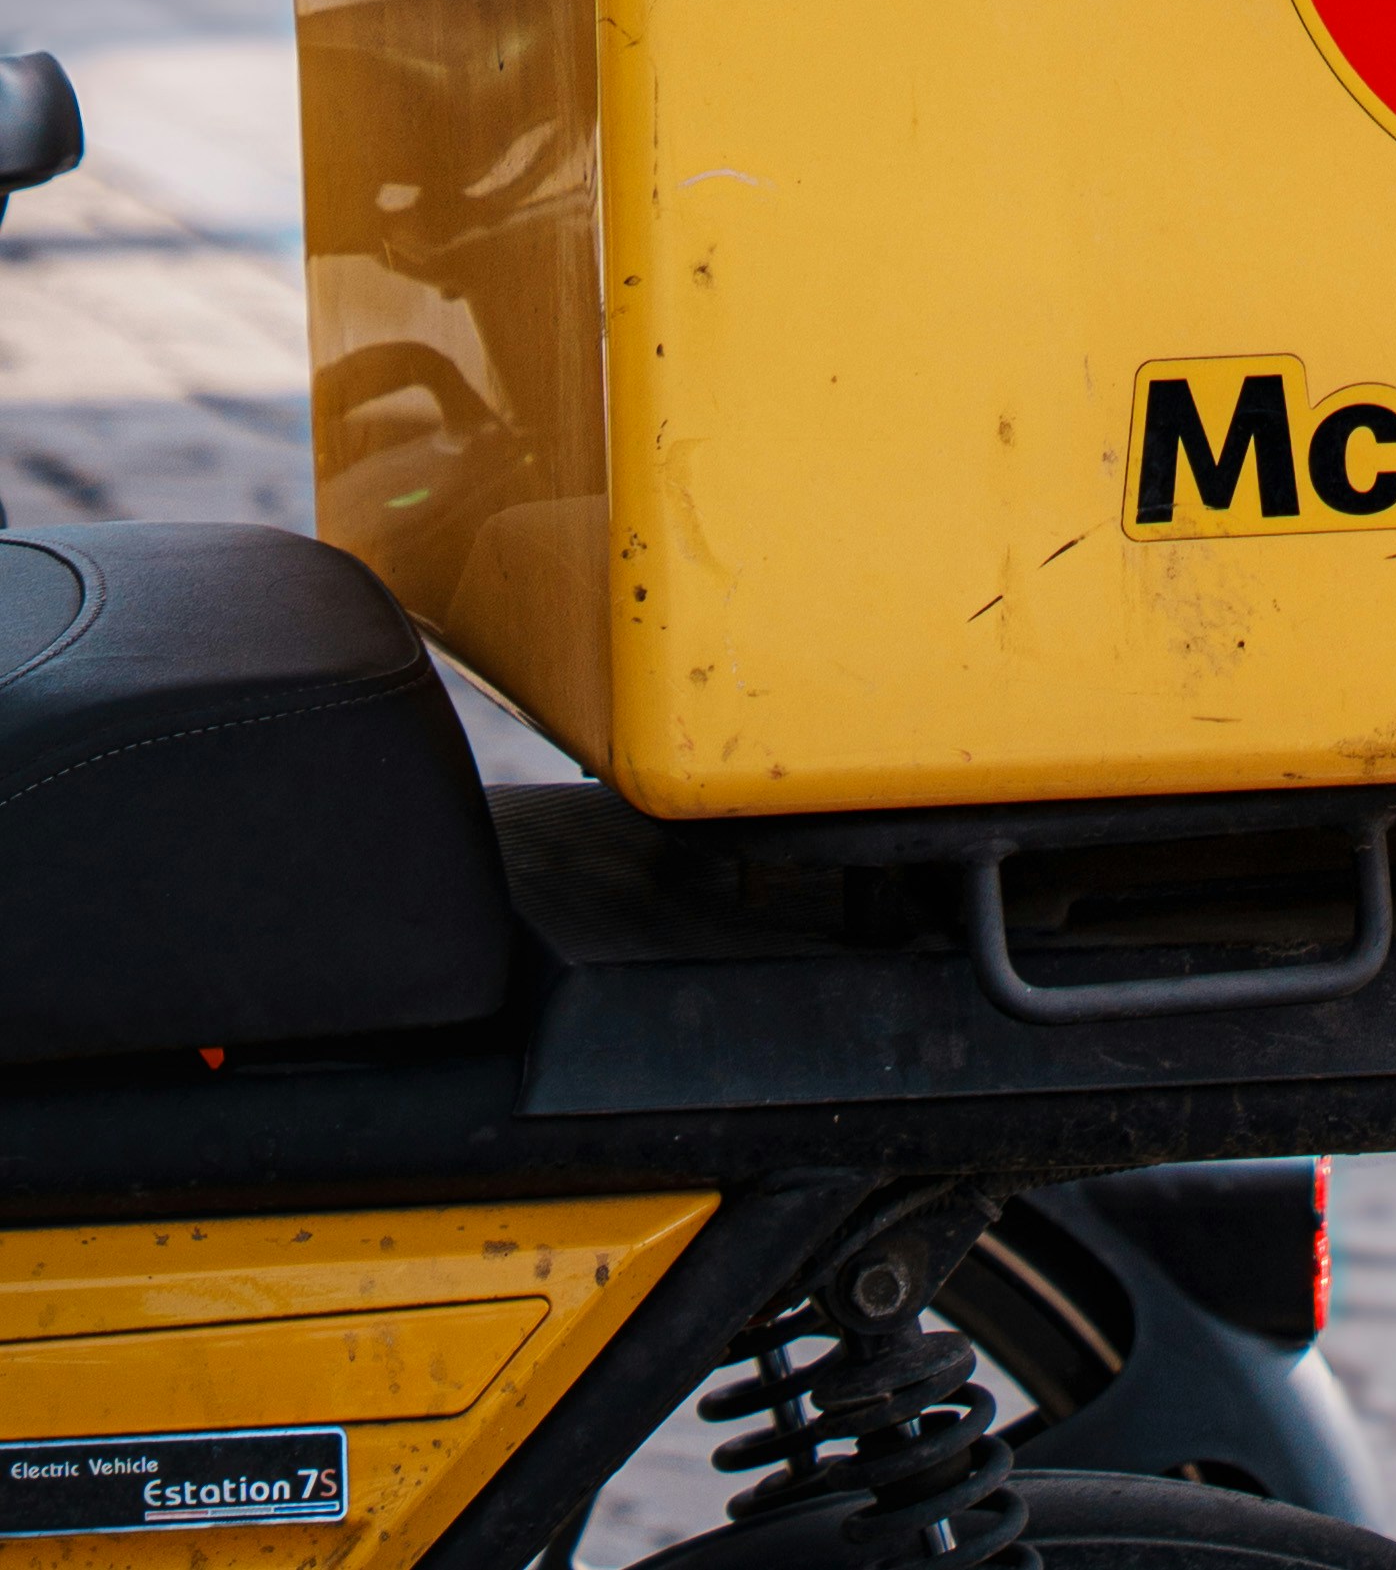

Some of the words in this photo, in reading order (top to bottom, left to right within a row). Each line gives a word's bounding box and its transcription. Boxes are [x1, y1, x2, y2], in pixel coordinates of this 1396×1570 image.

[10, 1459, 80, 1479] Electric
[88, 1456, 159, 1476] Vehicle
[143, 1475, 291, 1507] Estation
[297, 1468, 338, 1500] 7S
